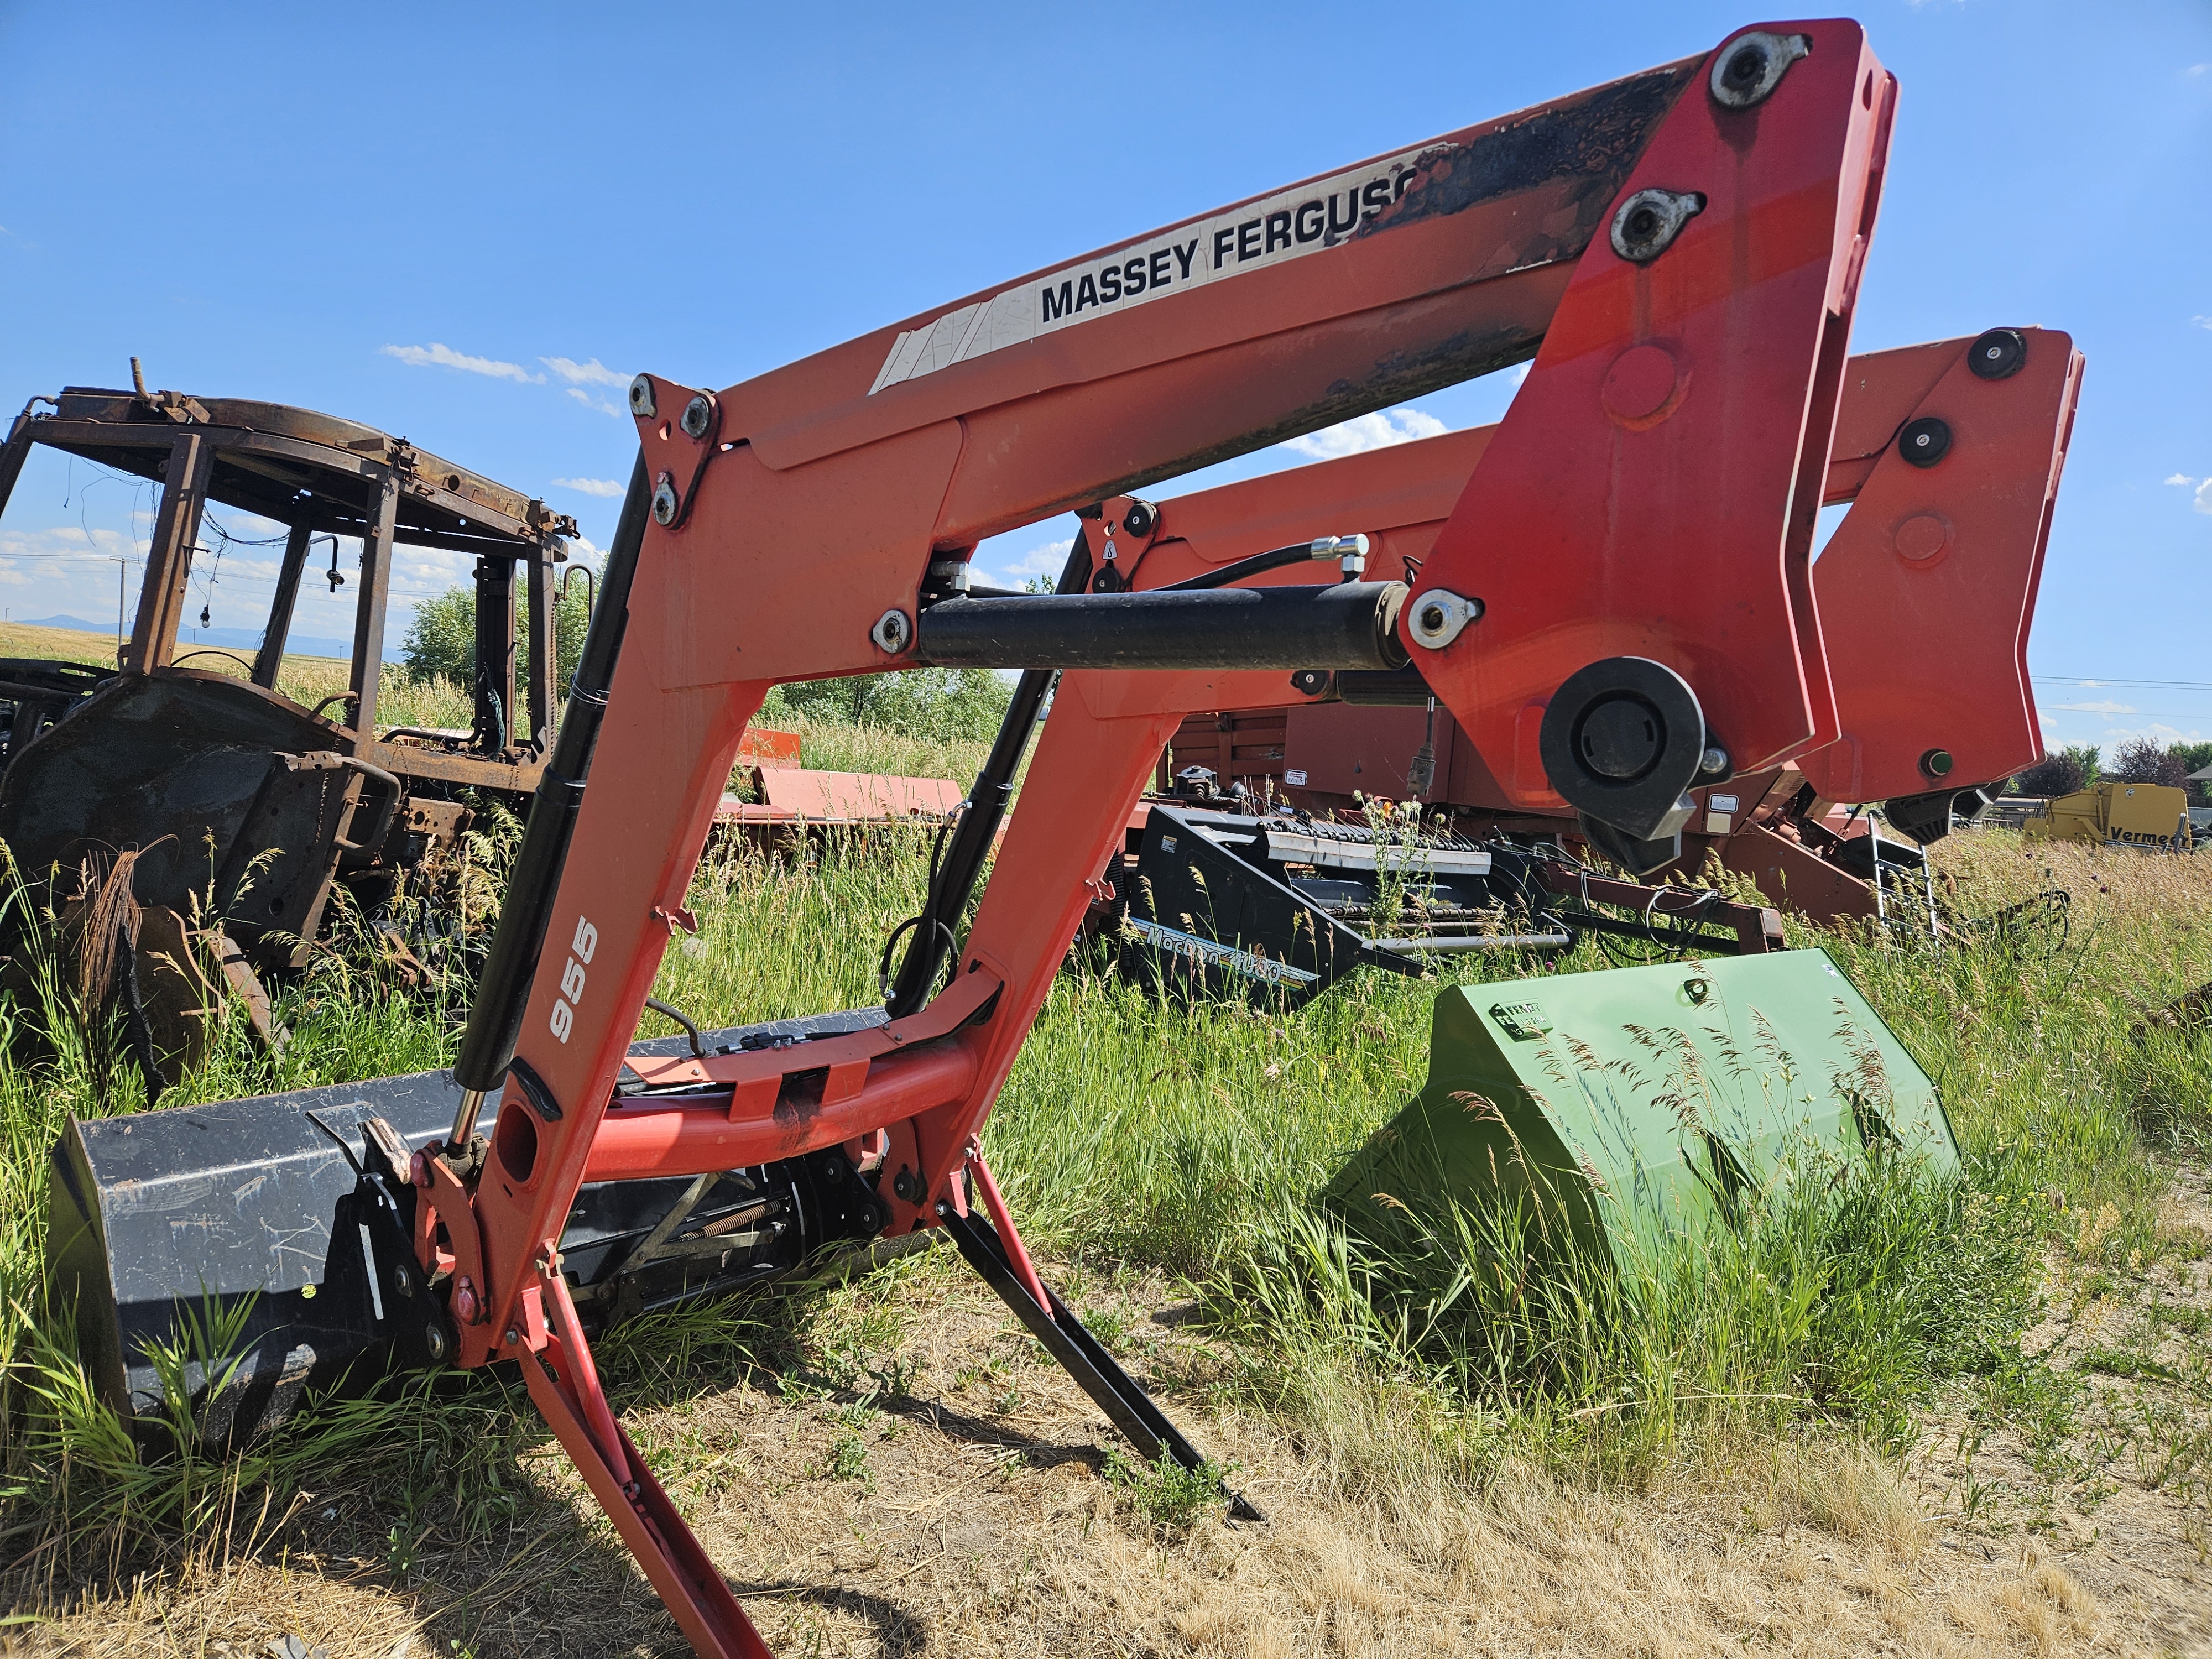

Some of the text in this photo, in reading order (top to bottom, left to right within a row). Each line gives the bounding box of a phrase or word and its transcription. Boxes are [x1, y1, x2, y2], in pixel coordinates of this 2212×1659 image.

[1042, 238, 1199, 323] MASSEY
[549, 914, 598, 1044] 955
[1146, 926, 1282, 983] MacDon 4000
